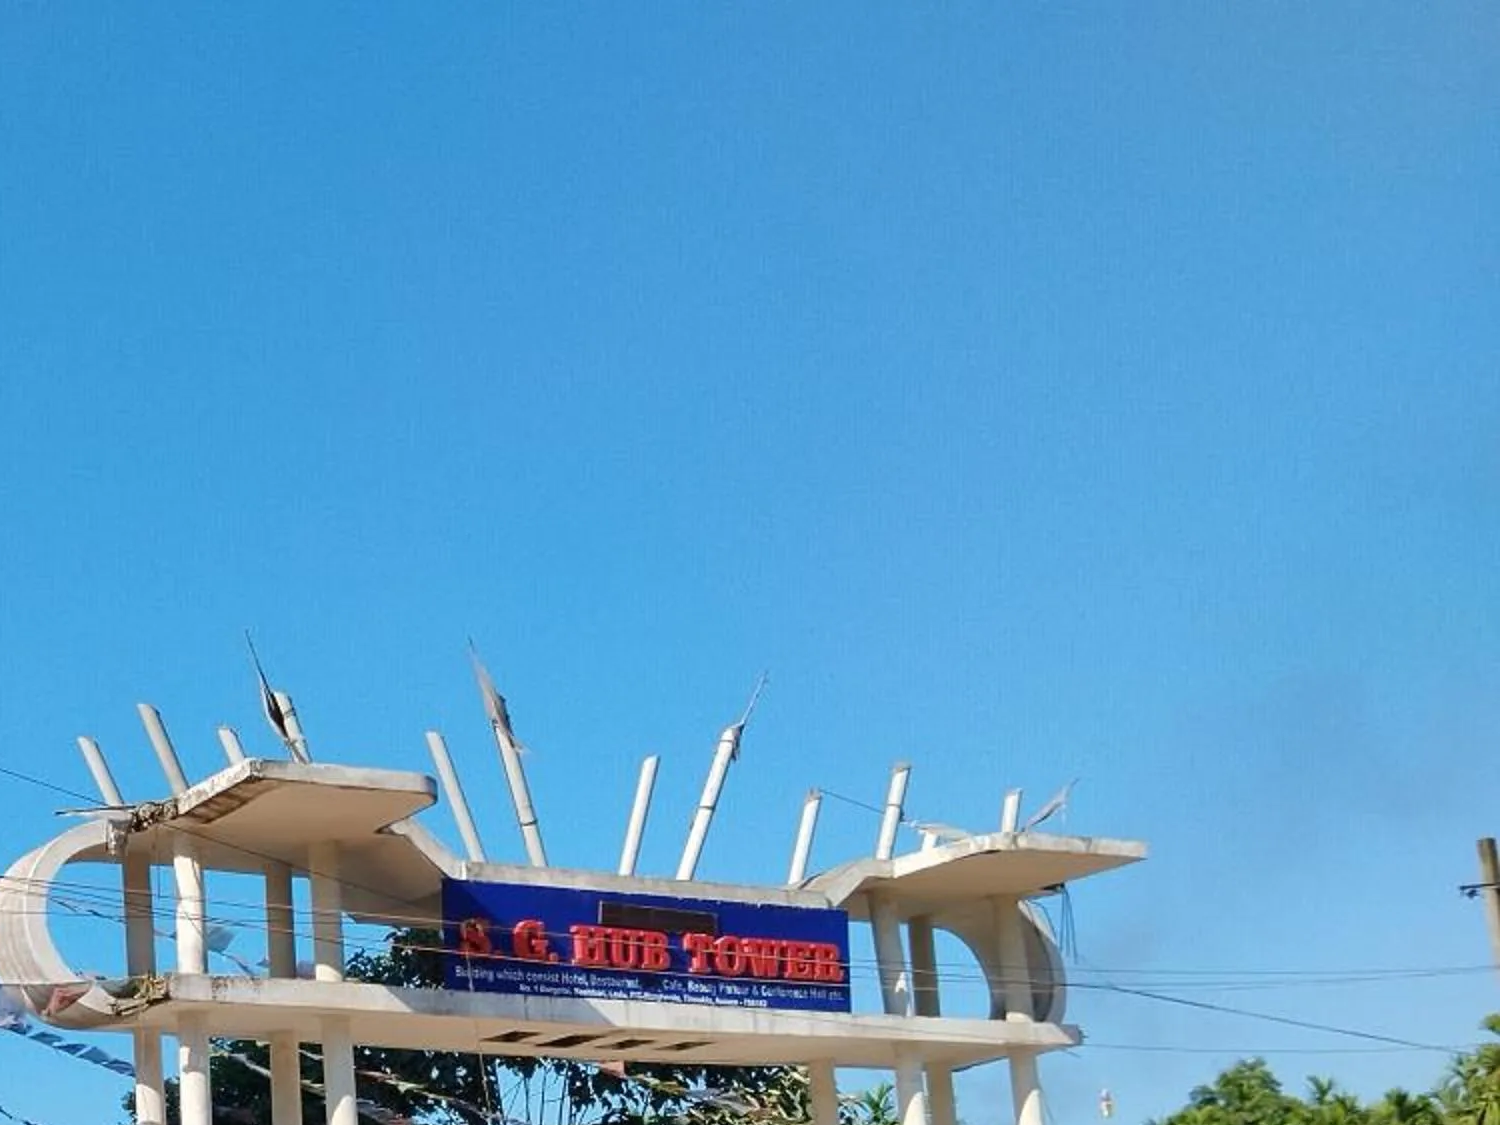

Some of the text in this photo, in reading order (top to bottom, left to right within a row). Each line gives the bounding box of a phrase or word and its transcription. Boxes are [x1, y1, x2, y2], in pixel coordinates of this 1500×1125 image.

[513, 920, 558, 962] G.
[569, 924, 670, 970] HUB
[682, 933, 845, 982] TOWER
[455, 966, 495, 982] Building
[496, 968, 524, 981] which
[525, 971, 560, 983] consist
[810, 987, 827, 999] Hall
